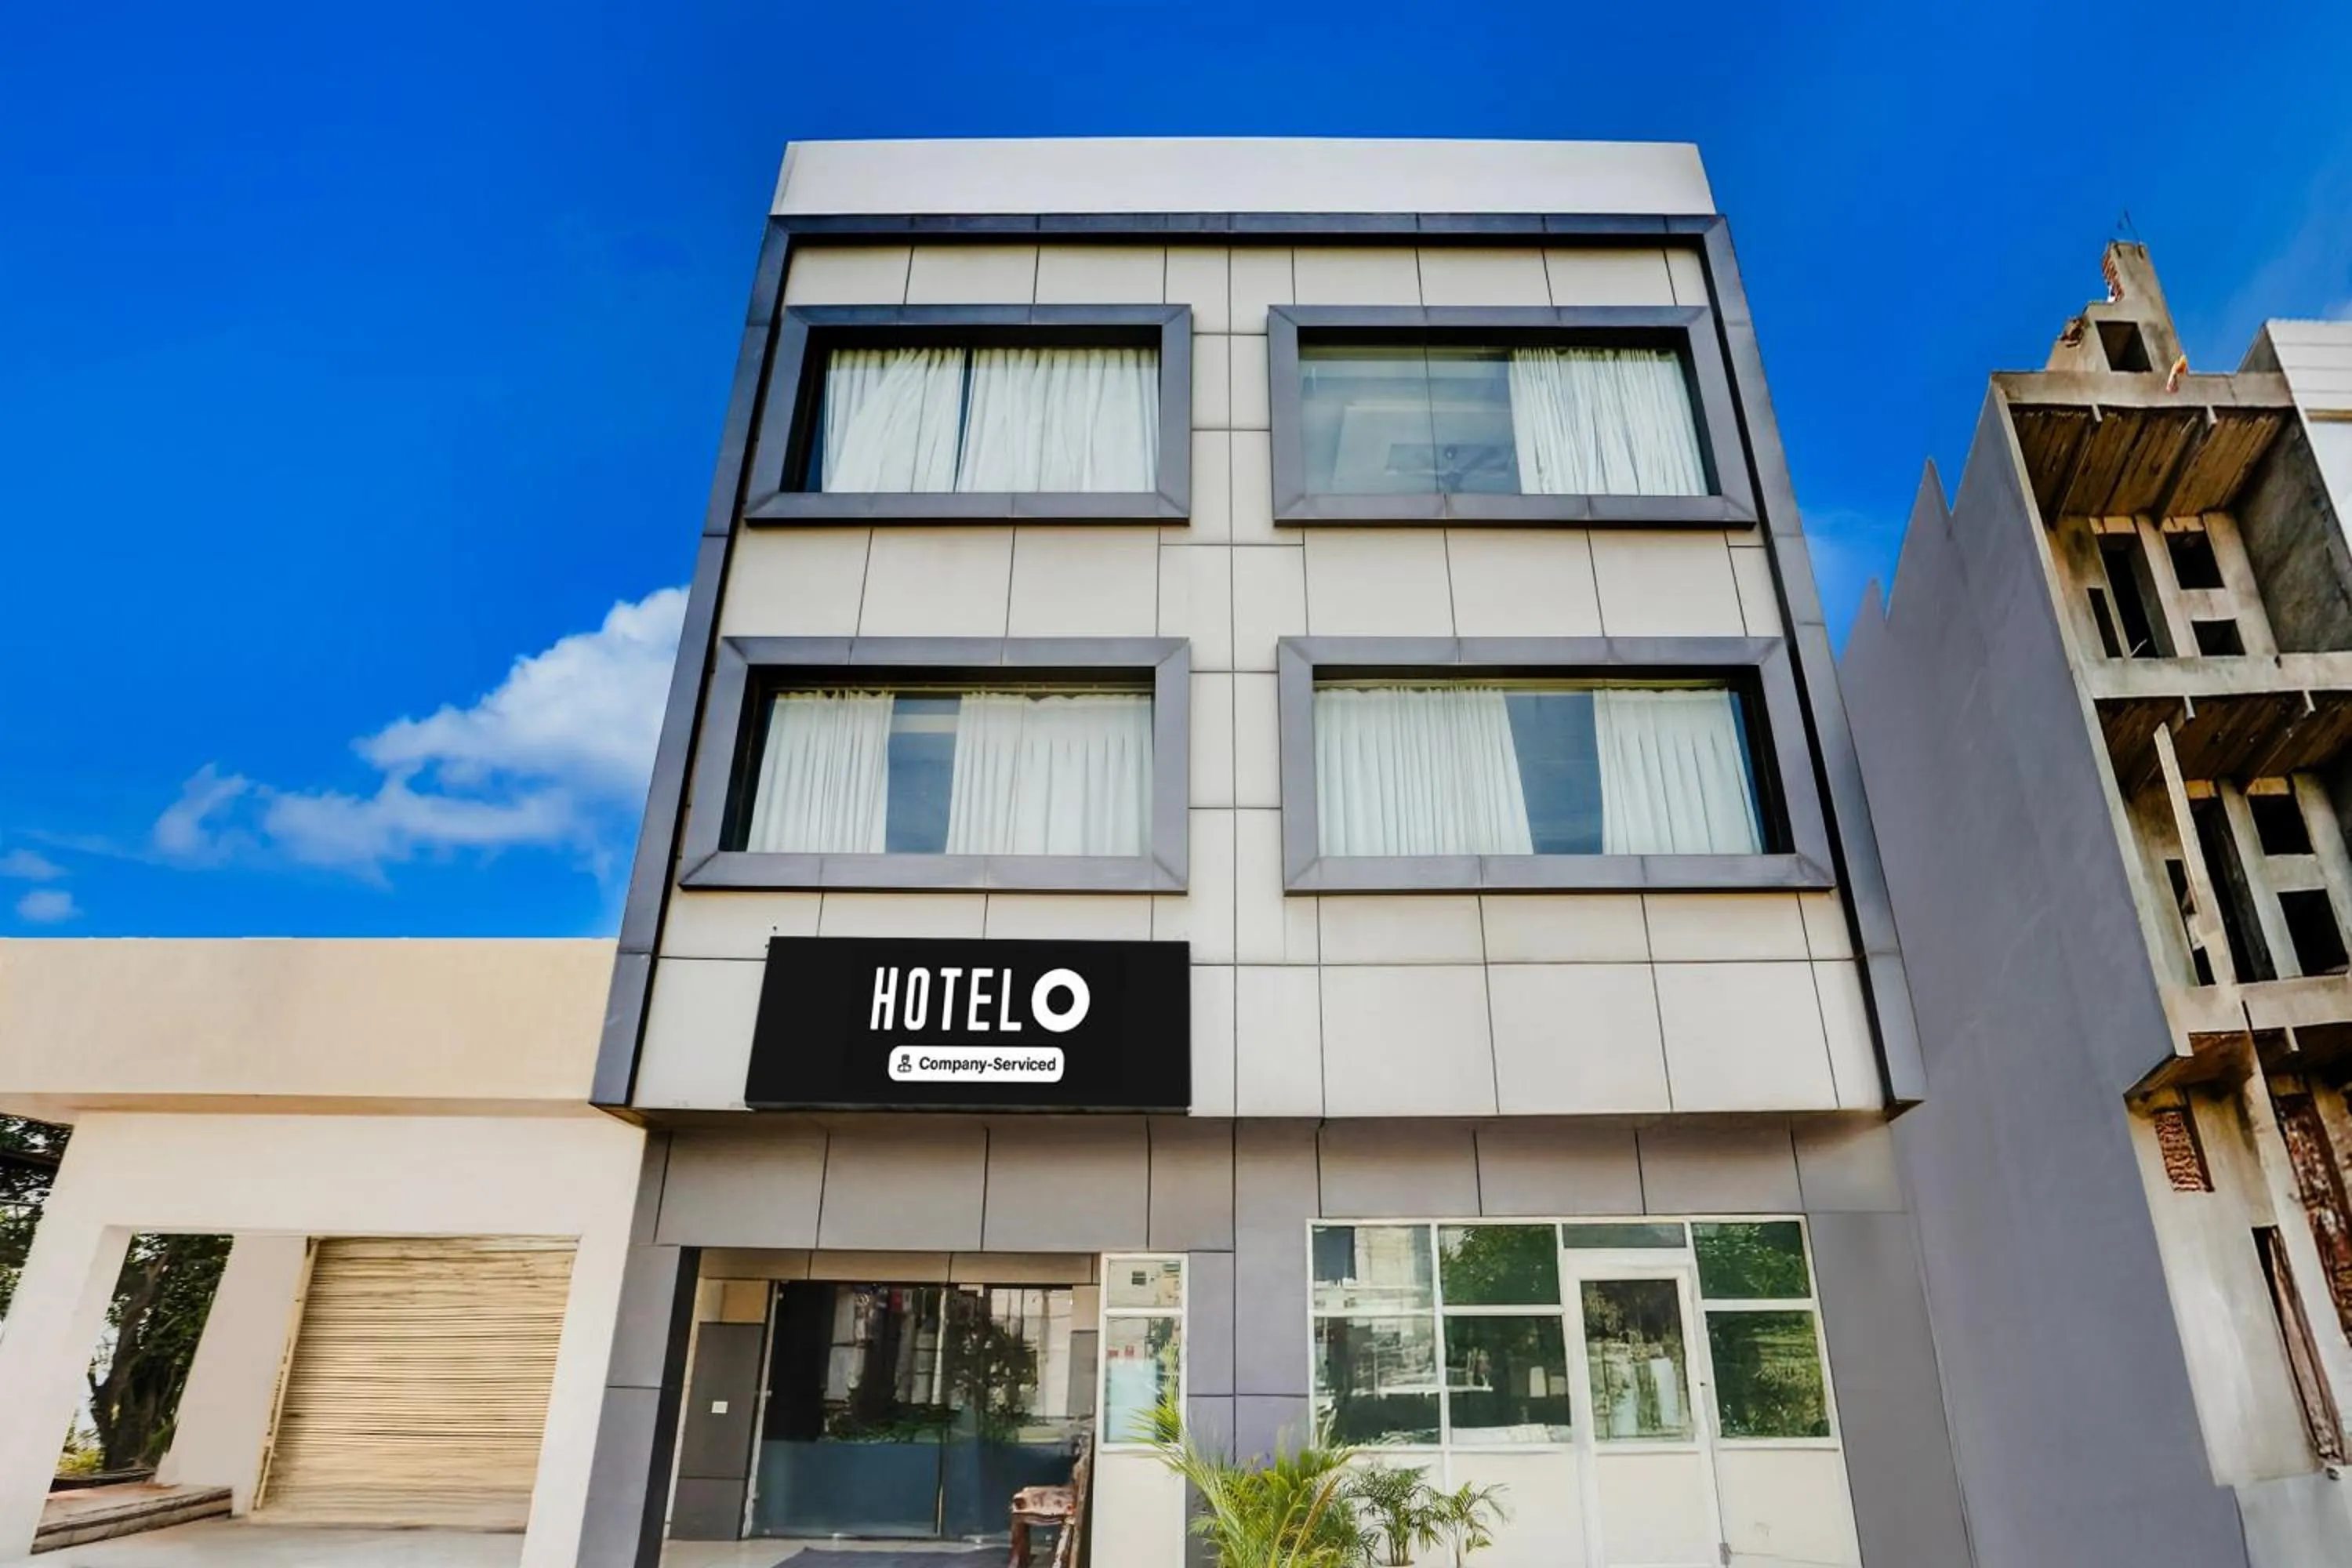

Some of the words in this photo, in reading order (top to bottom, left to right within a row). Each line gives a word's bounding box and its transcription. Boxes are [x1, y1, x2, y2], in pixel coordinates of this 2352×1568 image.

[869, 967, 1022, 1032] HOTEL
[1031, 968, 1091, 1033] O
[919, 1056, 1056, 1074] Company-Serviced
